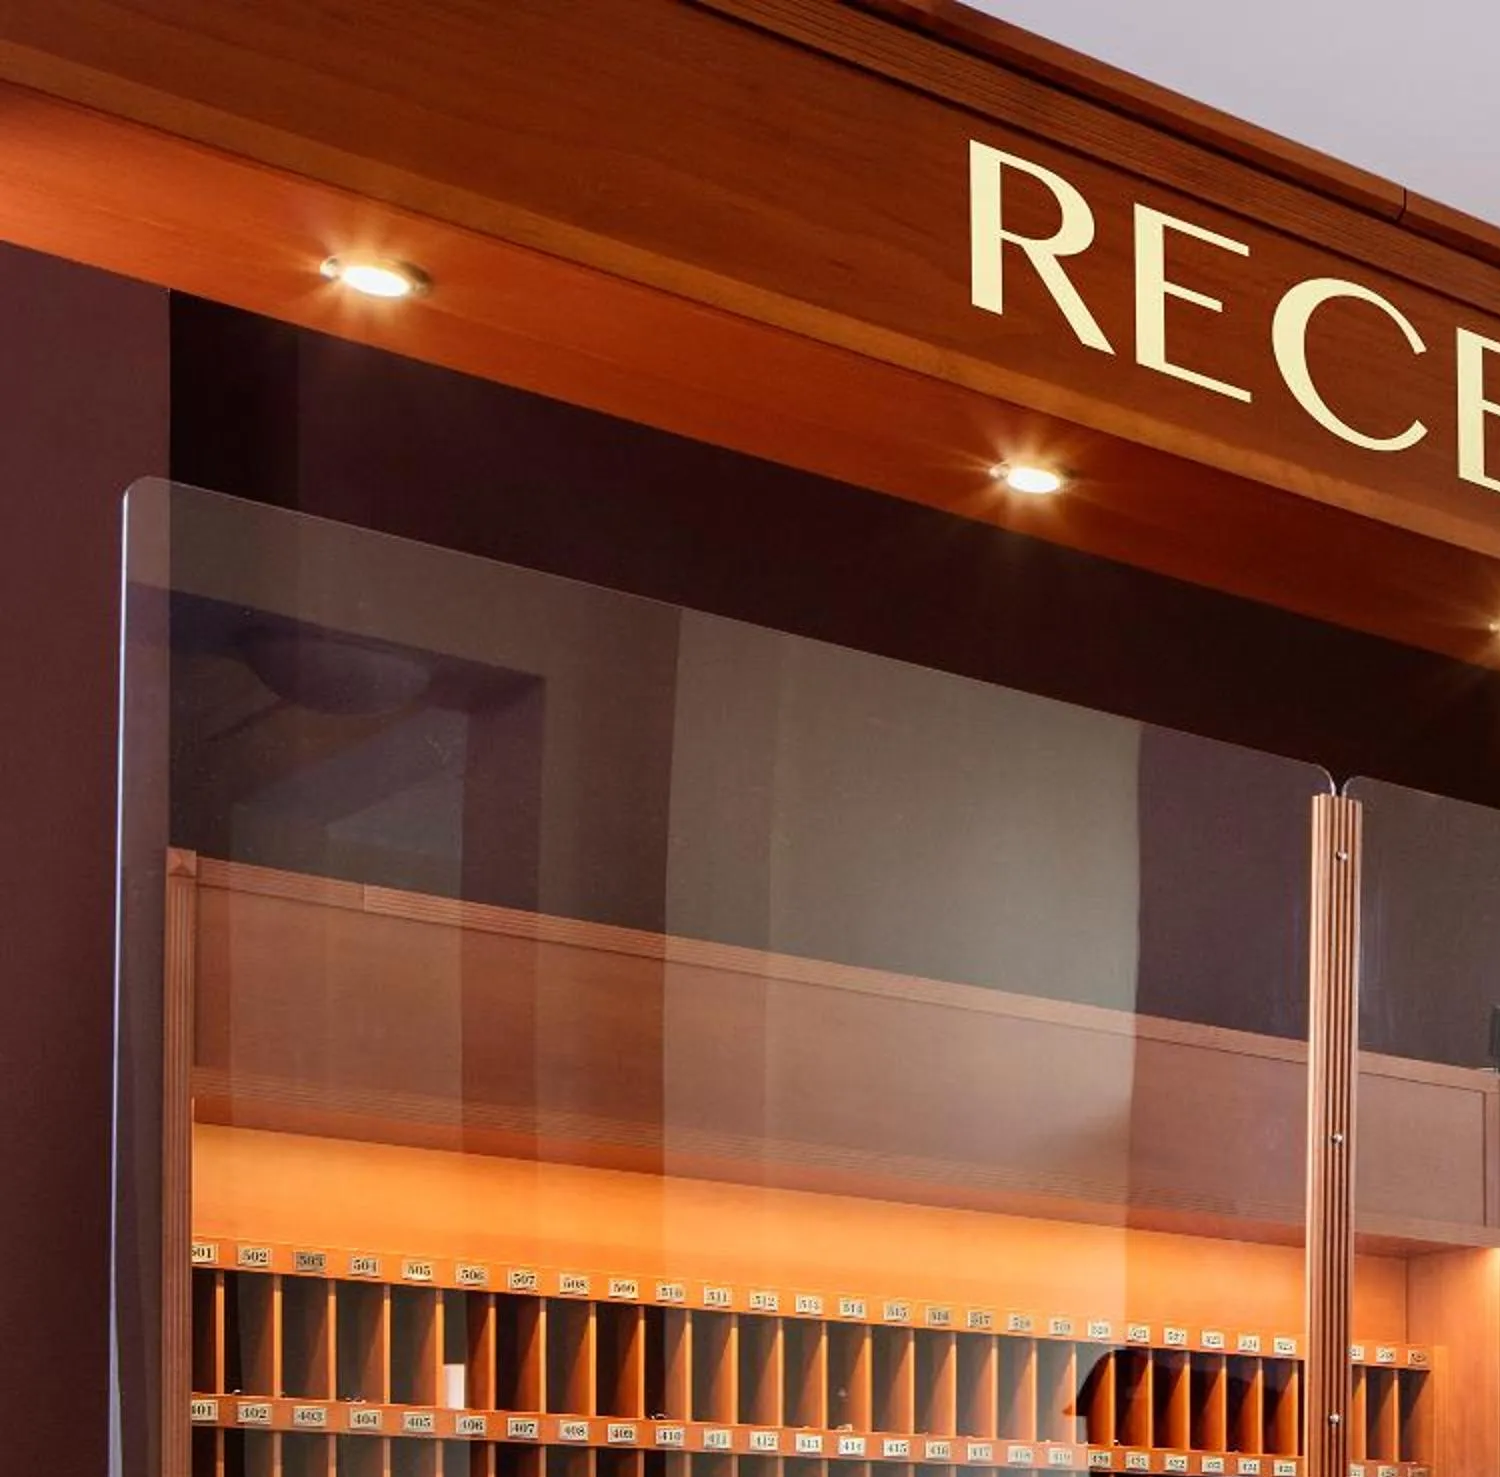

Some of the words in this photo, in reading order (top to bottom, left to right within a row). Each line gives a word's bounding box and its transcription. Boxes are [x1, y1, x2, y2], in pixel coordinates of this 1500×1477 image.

[241, 1250, 267, 1263] 502
[406, 1264, 432, 1276] 505
[460, 1269, 485, 1281] 506
[511, 1273, 536, 1287] 507
[563, 1278, 586, 1291] 508
[707, 1290, 729, 1303] 511
[754, 1295, 775, 1307] 512
[241, 1407, 267, 1419] 402
[353, 1412, 378, 1425] 404
[406, 1415, 432, 1428] 405
[460, 1419, 484, 1431] 406
[511, 1422, 535, 1435] 407
[658, 1430, 682, 1442] 410
[754, 1435, 775, 1448] 412
[886, 1442, 907, 1454] 415
